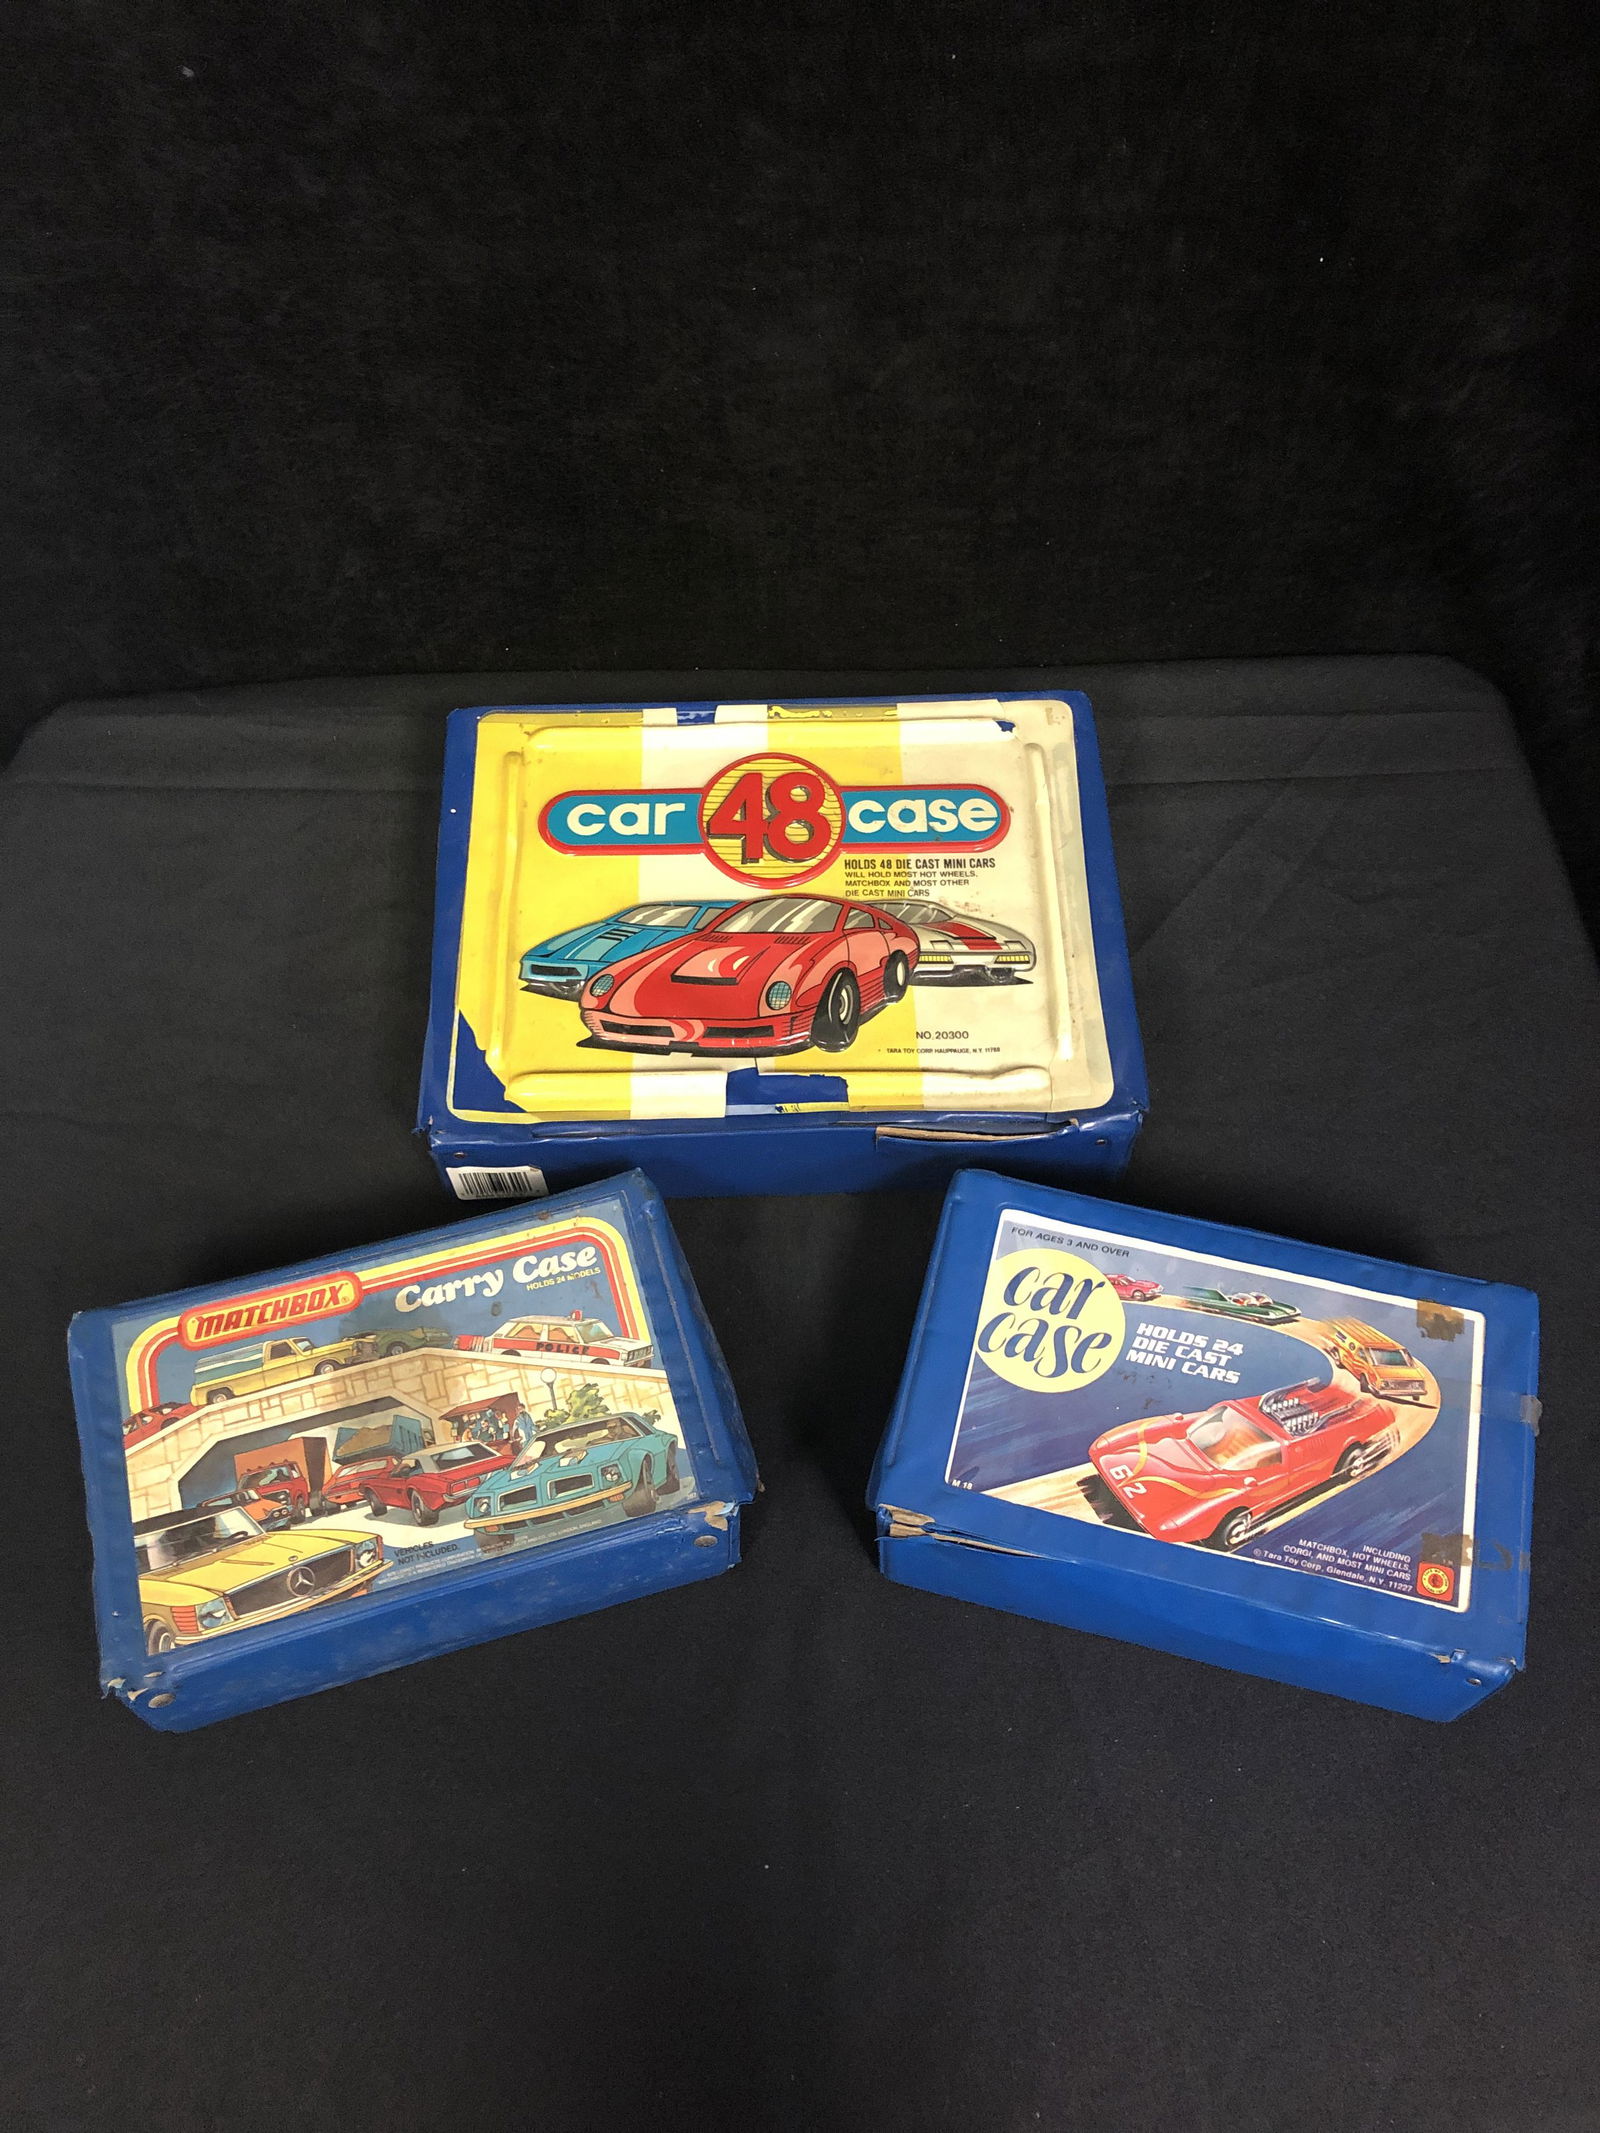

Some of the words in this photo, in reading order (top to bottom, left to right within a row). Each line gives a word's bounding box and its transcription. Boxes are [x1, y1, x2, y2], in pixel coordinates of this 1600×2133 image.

[567, 799, 685, 836] car
[707, 772, 832, 864] 48
[848, 797, 998, 834] case
[844, 859, 876, 869] HOLDS
[880, 859, 892, 869] 48
[896, 859, 912, 869] DIE
[915, 858, 941, 869] CAST
[944, 858, 966, 869] MINI
[969, 858, 996, 868] CARS
[907, 889, 930, 897] CARS
[1011, 1226, 1033, 1237] FOR
[1035, 1232, 1064, 1244] AGES
[1066, 1238, 1073, 1246] 3
[1075, 1240, 1098, 1251] AND
[1101, 1245, 1130, 1257] OVER
[395, 1268, 504, 1313] Carry
[512, 1246, 598, 1283] Case
[526, 1278, 555, 1291] HOLDS
[567, 1267, 601, 1281] MODELS
[1003, 1266, 1106, 1320] car
[536, 1341, 590, 1355] POLICE
[977, 1312, 1113, 1379] case
[1132, 1335, 1170, 1354] DIE
[1174, 1345, 1232, 1367] CAST
[1136, 1322, 1209, 1348] HOLDS
[1212, 1338, 1244, 1356] 24
[1125, 1349, 1177, 1371] MINI
[1181, 1361, 1241, 1384] CARS
[1109, 1464, 1147, 1499] 62
[393, 1540, 434, 1558] VEHICLES
[397, 1555, 414, 1565] NOT
[1263, 1550, 1282, 1561] Tara
[1284, 1555, 1299, 1566] Toy
[1352, 1552, 1371, 1562] HOT
[1362, 1545, 1411, 1563] INCLUDING
[1316, 1552, 1335, 1563] AND
[1337, 1557, 1362, 1569] MOST
[1364, 1563, 1385, 1574] MINI
[1386, 1569, 1411, 1581] CARS
